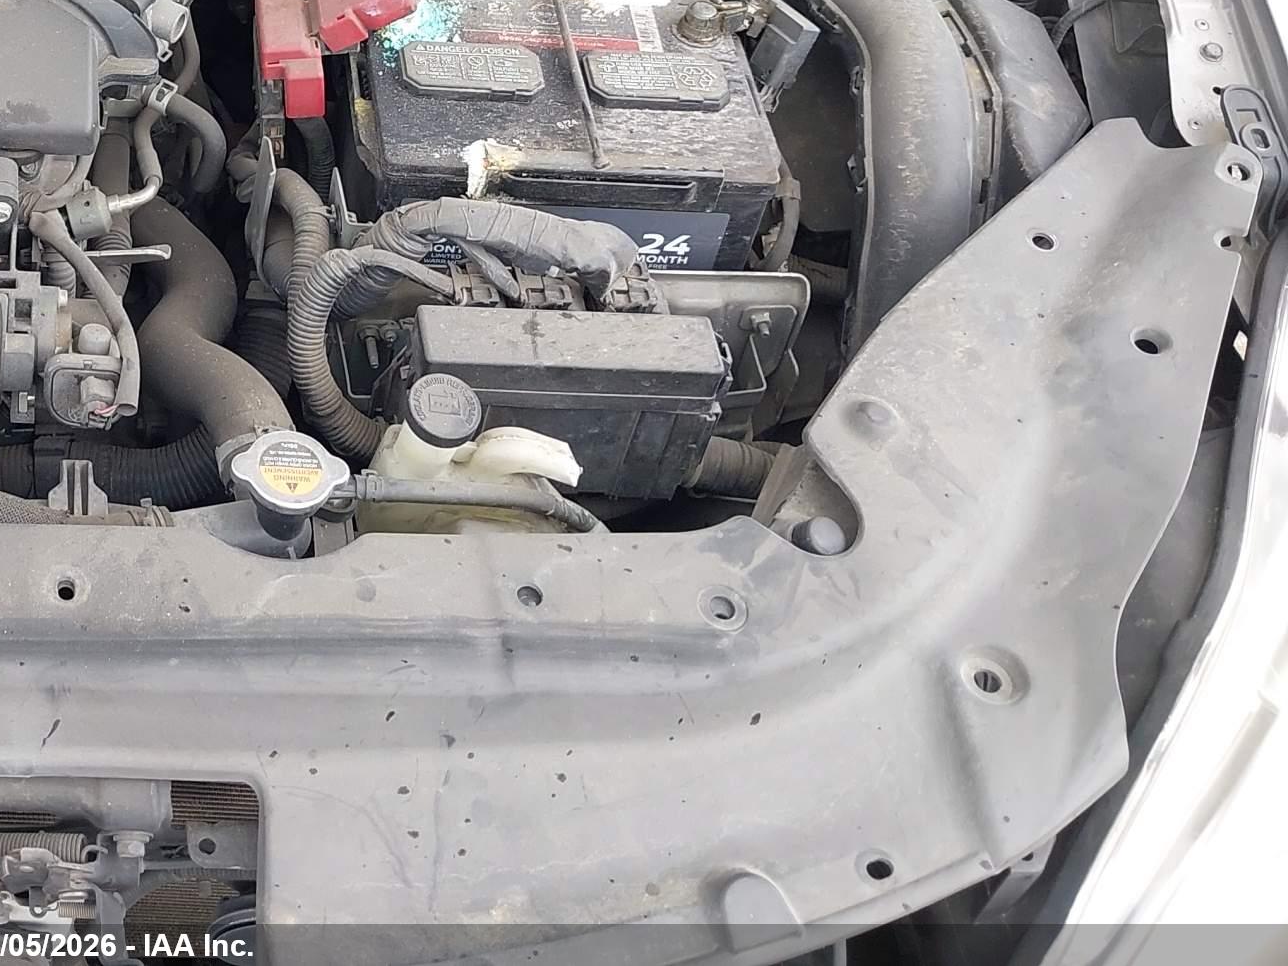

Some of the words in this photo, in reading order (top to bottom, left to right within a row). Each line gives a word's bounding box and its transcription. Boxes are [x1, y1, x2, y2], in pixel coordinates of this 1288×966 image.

[426, 44, 470, 54] DANGER
[480, 46, 521, 55] POISON
[637, 233, 692, 255] 24
[635, 254, 689, 265] MONTH
